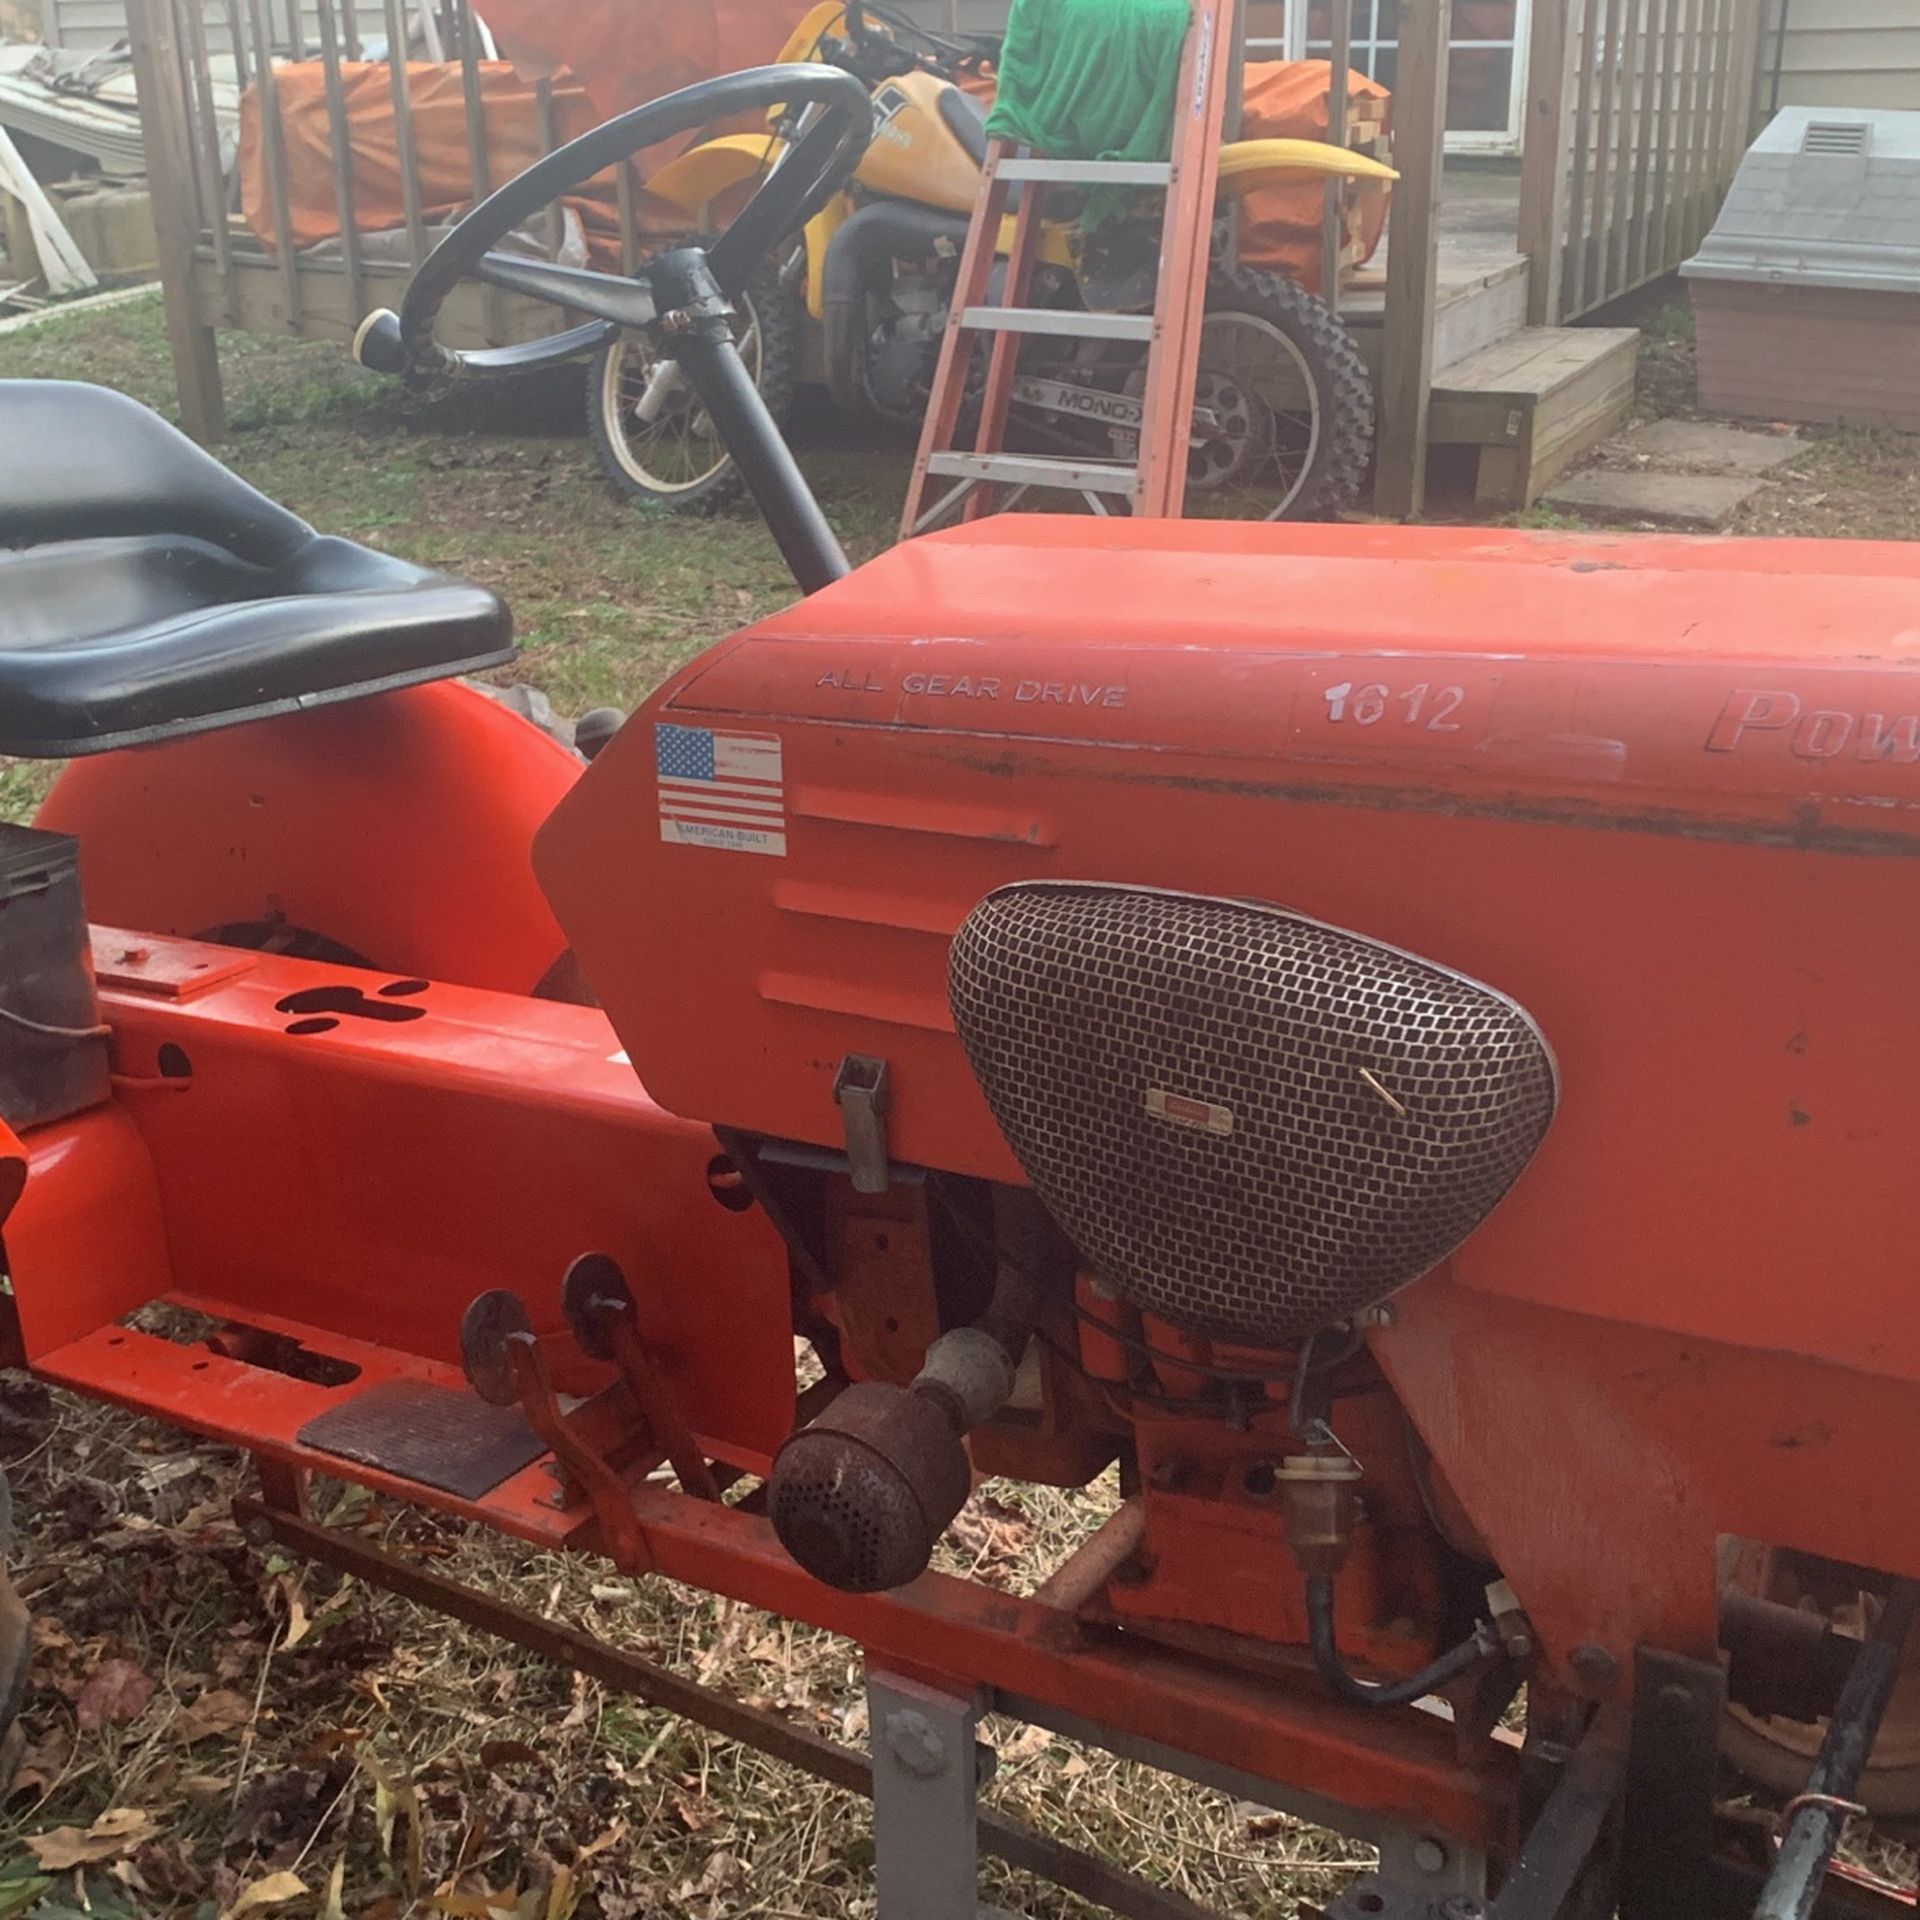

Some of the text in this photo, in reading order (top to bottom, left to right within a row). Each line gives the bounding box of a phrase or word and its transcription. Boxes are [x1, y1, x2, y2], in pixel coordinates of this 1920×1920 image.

[816, 669, 1128, 708] ALL GEAR DRIVE
[1323, 681, 1465, 732] 1612
